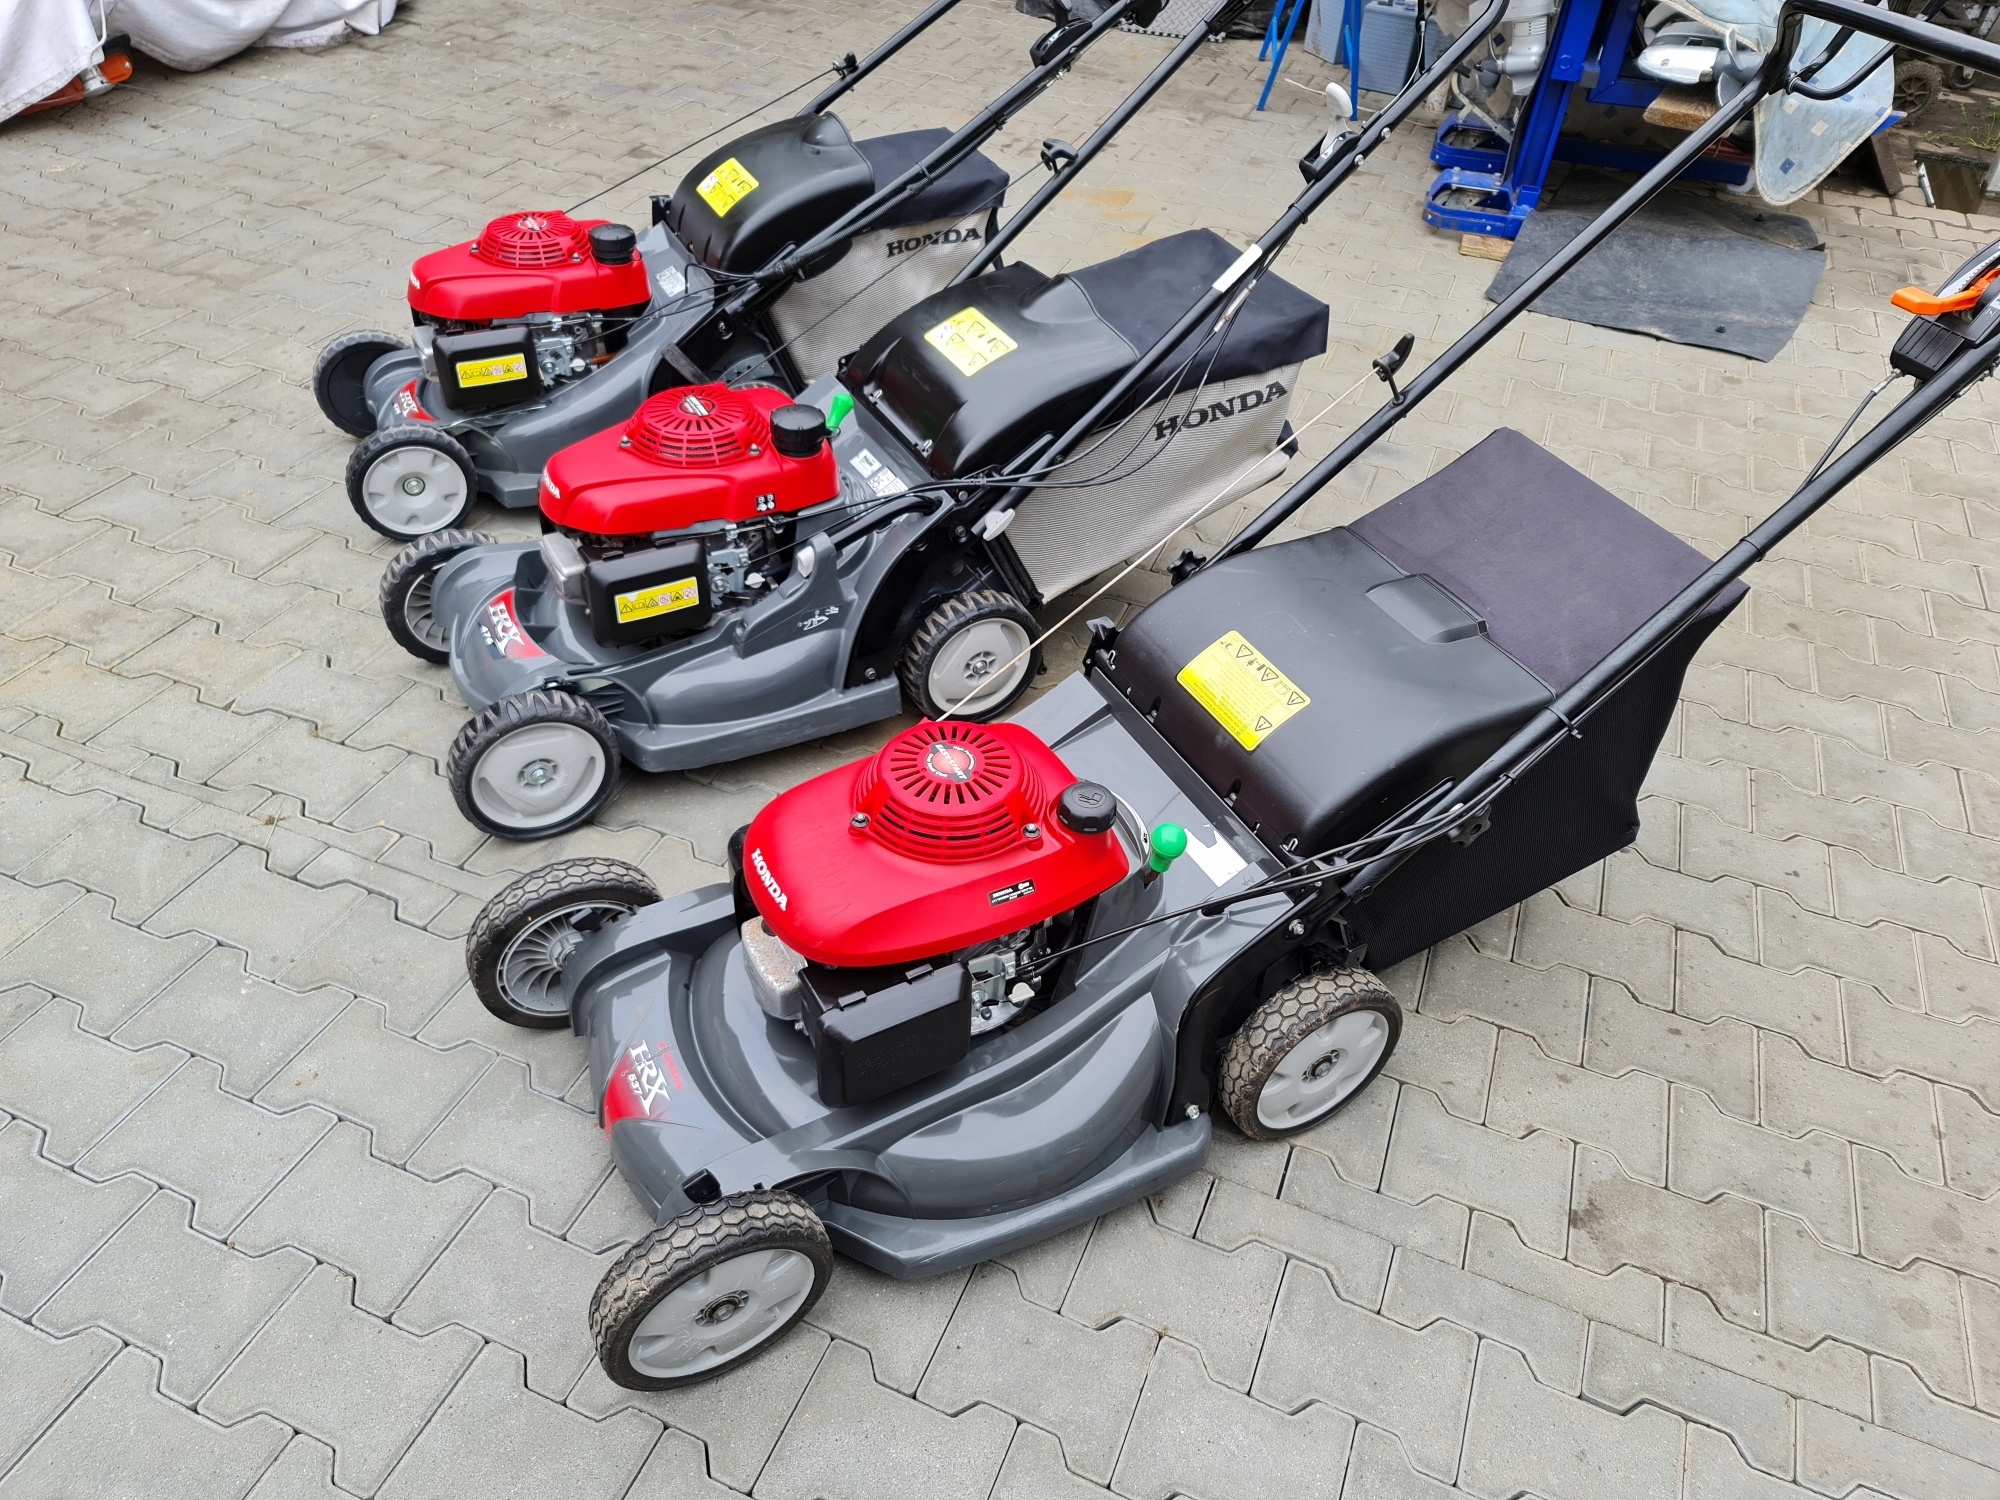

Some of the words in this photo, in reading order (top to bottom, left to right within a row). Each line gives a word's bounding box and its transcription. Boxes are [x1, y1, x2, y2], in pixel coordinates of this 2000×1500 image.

[886, 228, 982, 257] HONDA
[399, 389, 418, 417] HRX
[1154, 381, 1288, 441] HONDA
[488, 600, 525, 655] HRX
[751, 847, 788, 911] HONDA
[627, 1073, 643, 1096] 537
[629, 1040, 671, 1116] HRX
